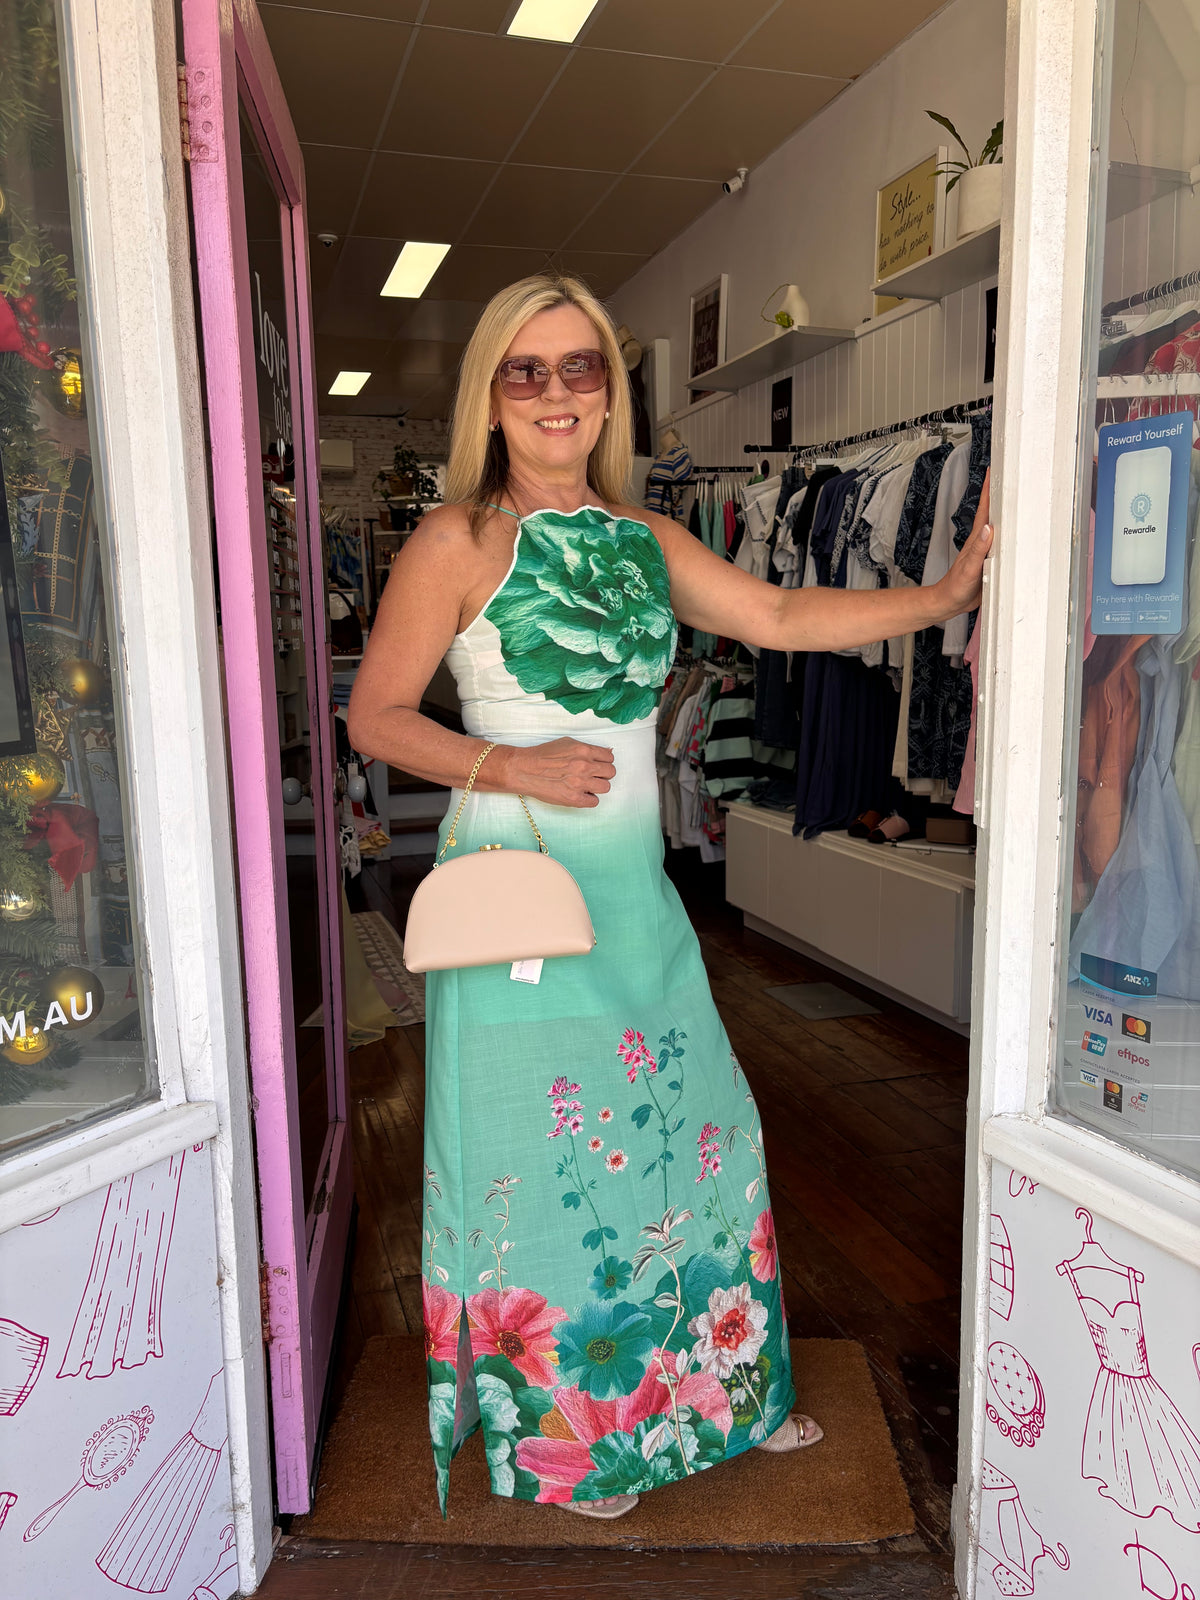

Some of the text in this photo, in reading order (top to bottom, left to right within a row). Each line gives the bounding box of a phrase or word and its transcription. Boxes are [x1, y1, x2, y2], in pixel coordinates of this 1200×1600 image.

[894, 211, 924, 239] nothing
[926, 202, 935, 215] to
[889, 239, 907, 264] with
[254, 271, 289, 398] love
[773, 406, 789, 422] NEW
[1107, 423, 1184, 447] Reward Yourself
[1123, 525, 1156, 536] Rewardle
[1096, 592, 1180, 605] Pay here with Rewardle
[1123, 973, 1142, 985] ANZ
[0, 991, 93, 1045] M.AU
[1082, 1004, 1113, 1027] VISA
[1117, 1048, 1150, 1067] eftpos
[1082, 1073, 1096, 1084] VISA
